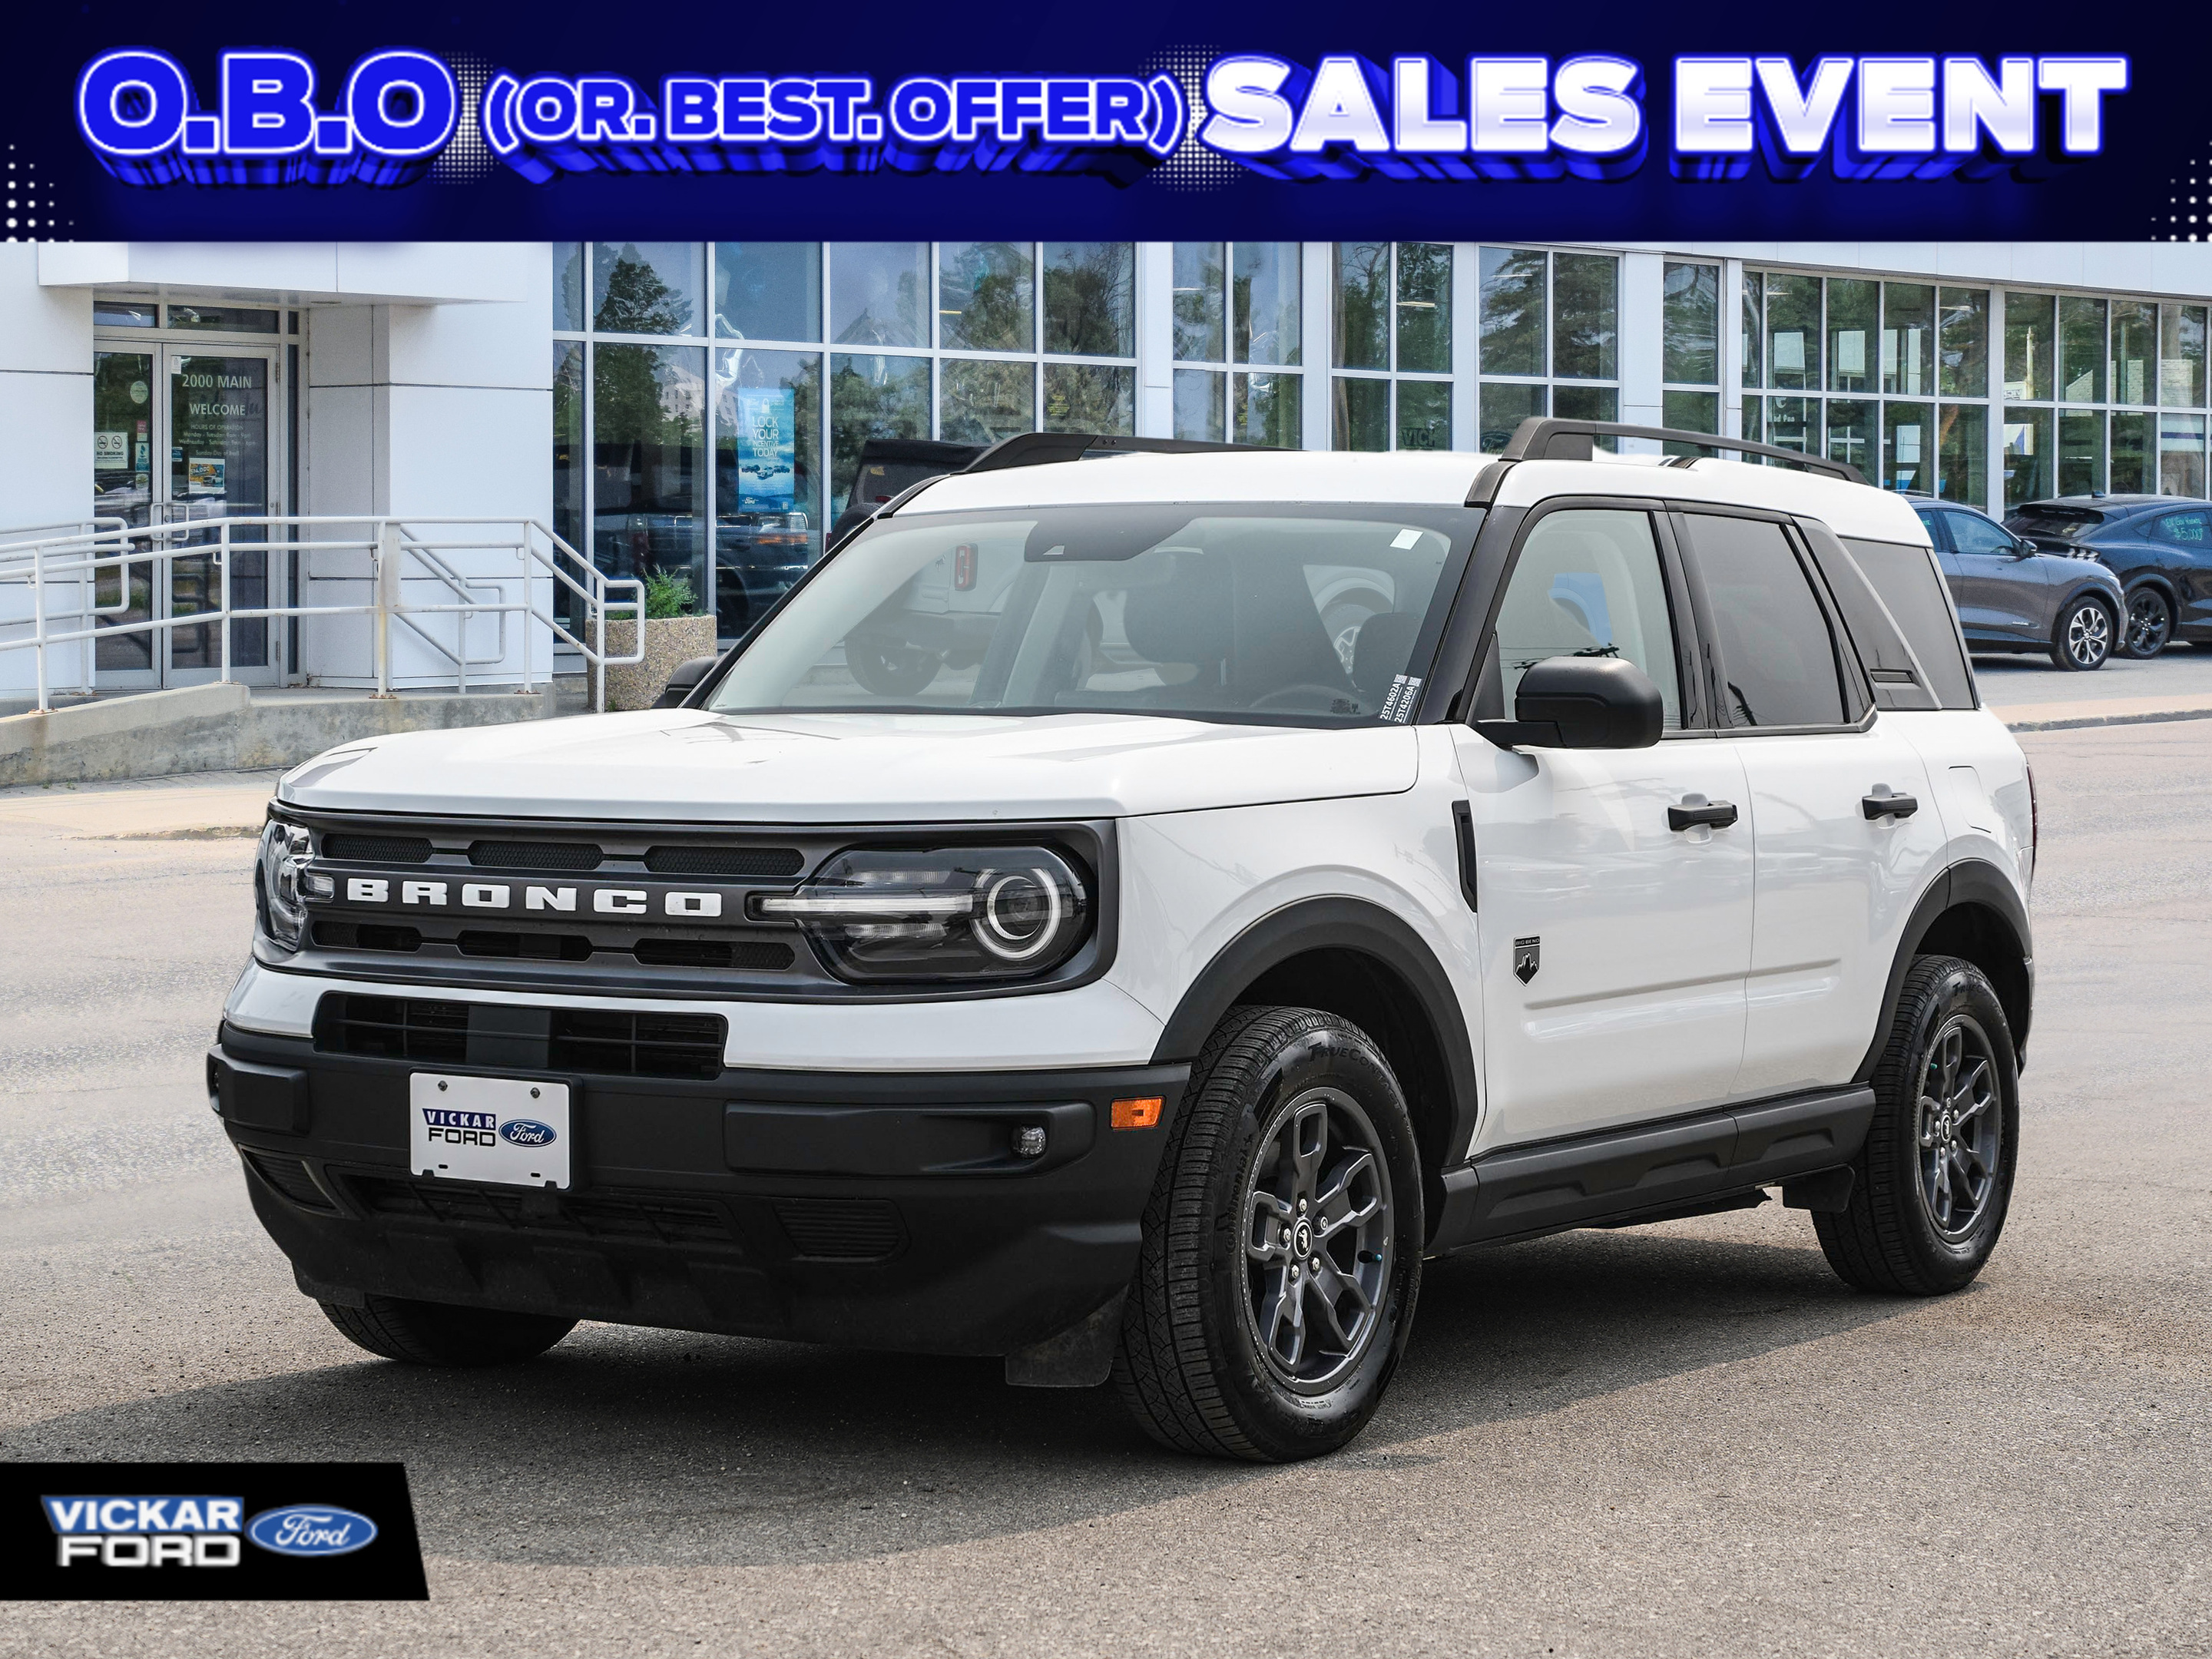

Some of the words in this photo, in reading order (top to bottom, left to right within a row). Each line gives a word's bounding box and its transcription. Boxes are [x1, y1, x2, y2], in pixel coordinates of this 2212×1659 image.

[182, 374, 214, 387] 2000
[217, 375, 252, 389] MAIN
[189, 403, 247, 416] WELCOME
[752, 416, 779, 428] LOCK
[752, 429, 780, 439] YOUR
[753, 448, 779, 457] TODAY
[1379, 683, 1401, 720] 25T4602A
[1394, 686, 1416, 723] 25T4206A
[346, 878, 722, 916] BRONCO
[426, 1111, 495, 1128] VICKAR
[429, 1127, 496, 1147] FORD
[510, 1122, 545, 1144] Ford
